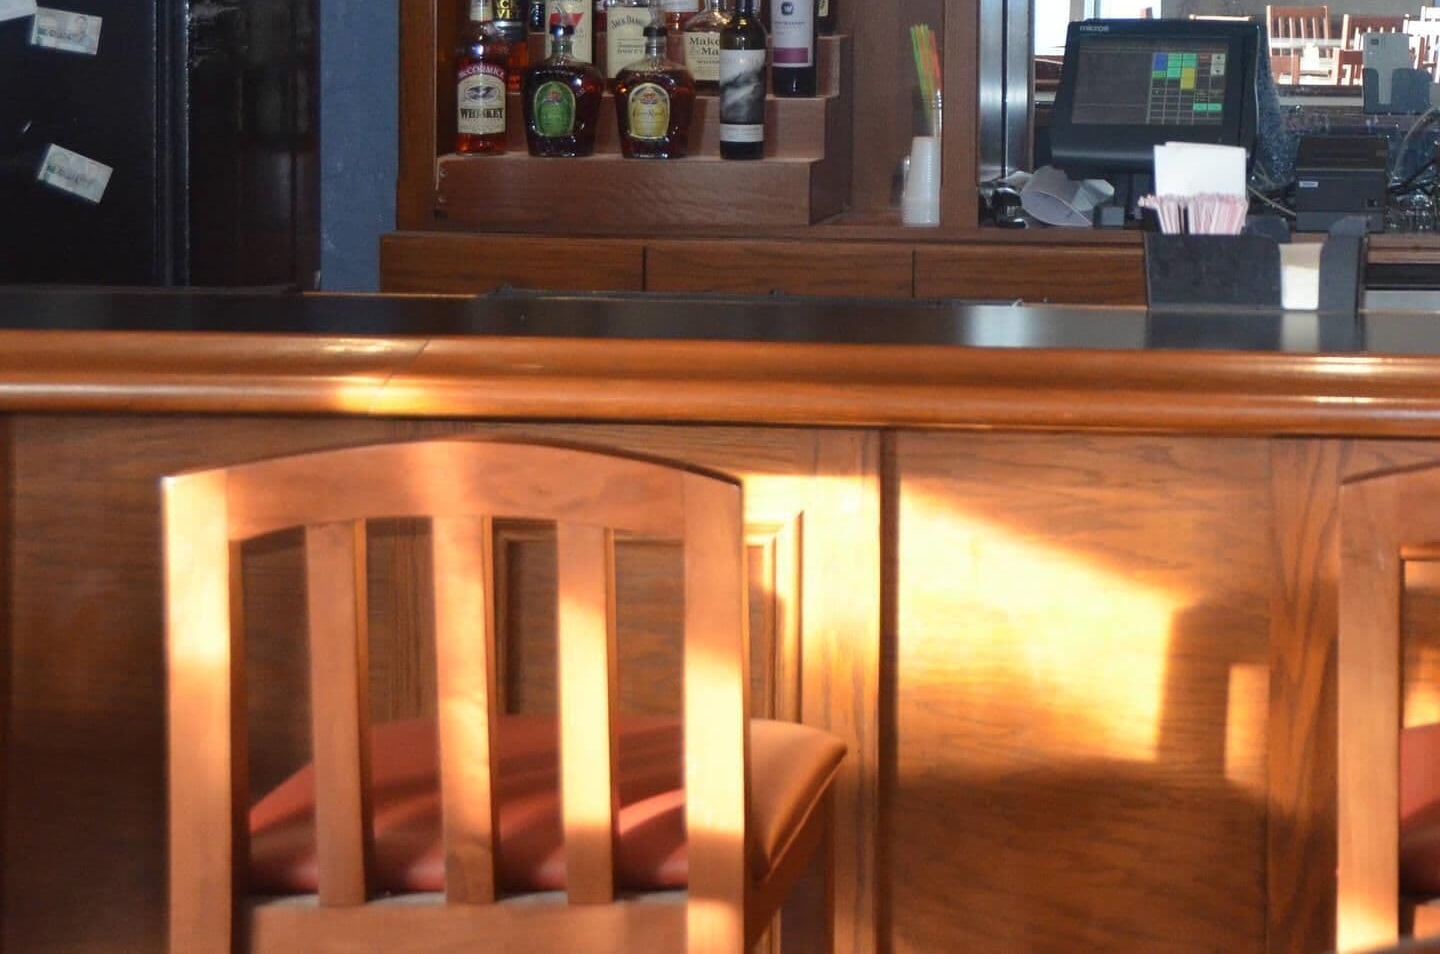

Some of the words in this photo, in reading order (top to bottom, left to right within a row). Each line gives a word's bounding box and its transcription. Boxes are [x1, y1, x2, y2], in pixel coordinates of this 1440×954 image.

[689, 36, 720, 47] Make
[701, 46, 720, 55] Ma
[460, 108, 503, 119] WHISKEY
